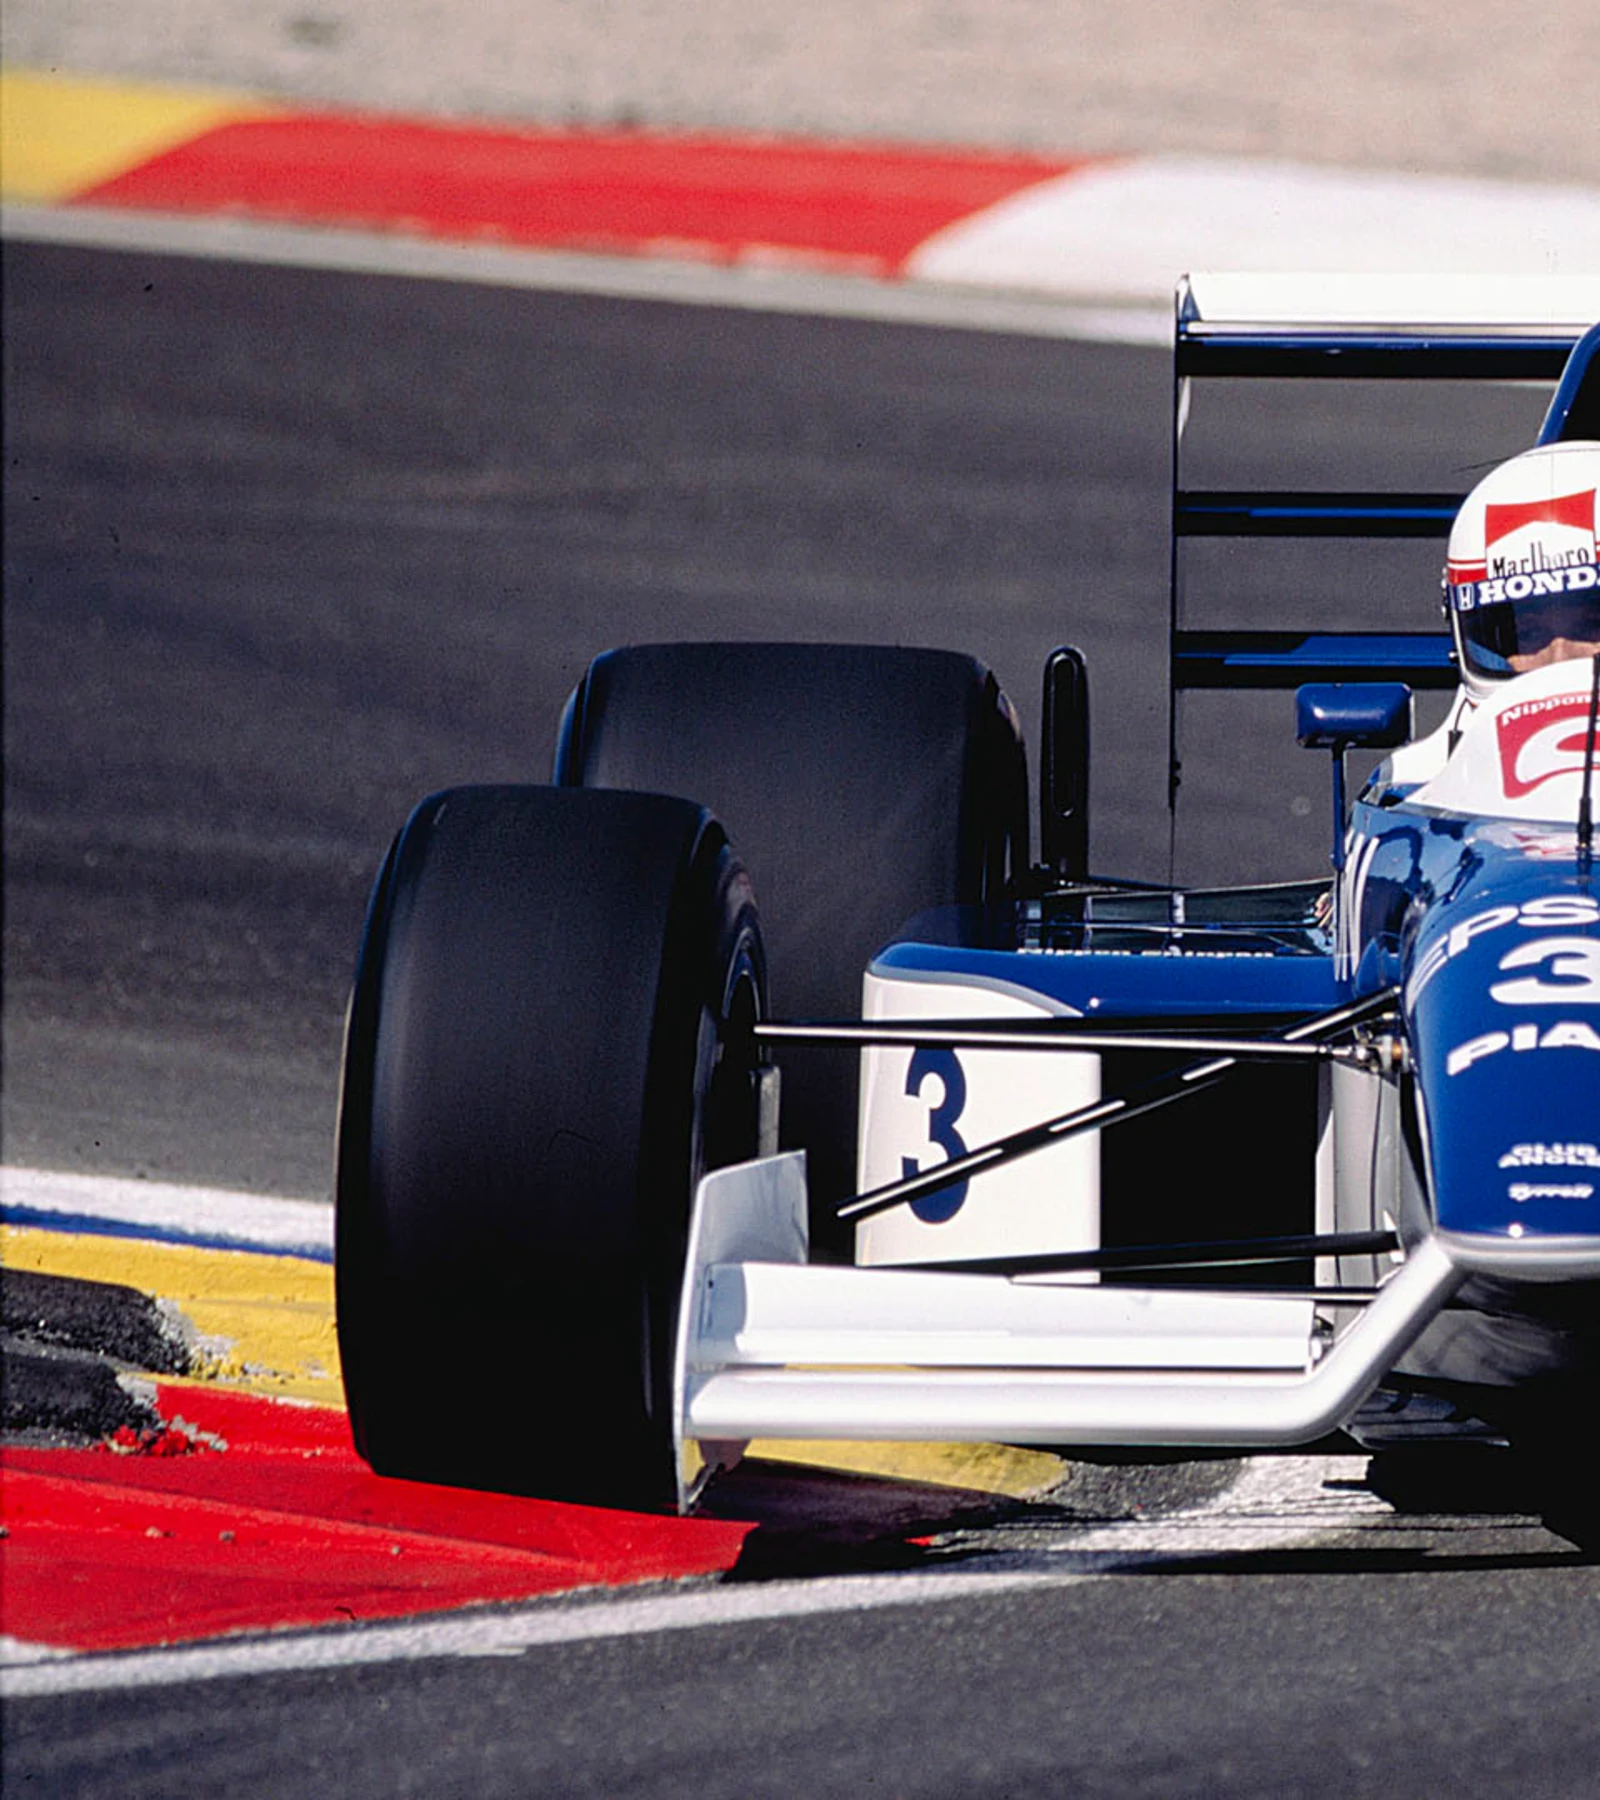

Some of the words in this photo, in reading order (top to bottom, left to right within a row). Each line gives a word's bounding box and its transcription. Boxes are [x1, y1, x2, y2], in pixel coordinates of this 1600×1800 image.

[1491, 541, 1590, 578] Marlboro
[1502, 692, 1593, 727] Nippon
[902, 1047, 970, 1224] 3
